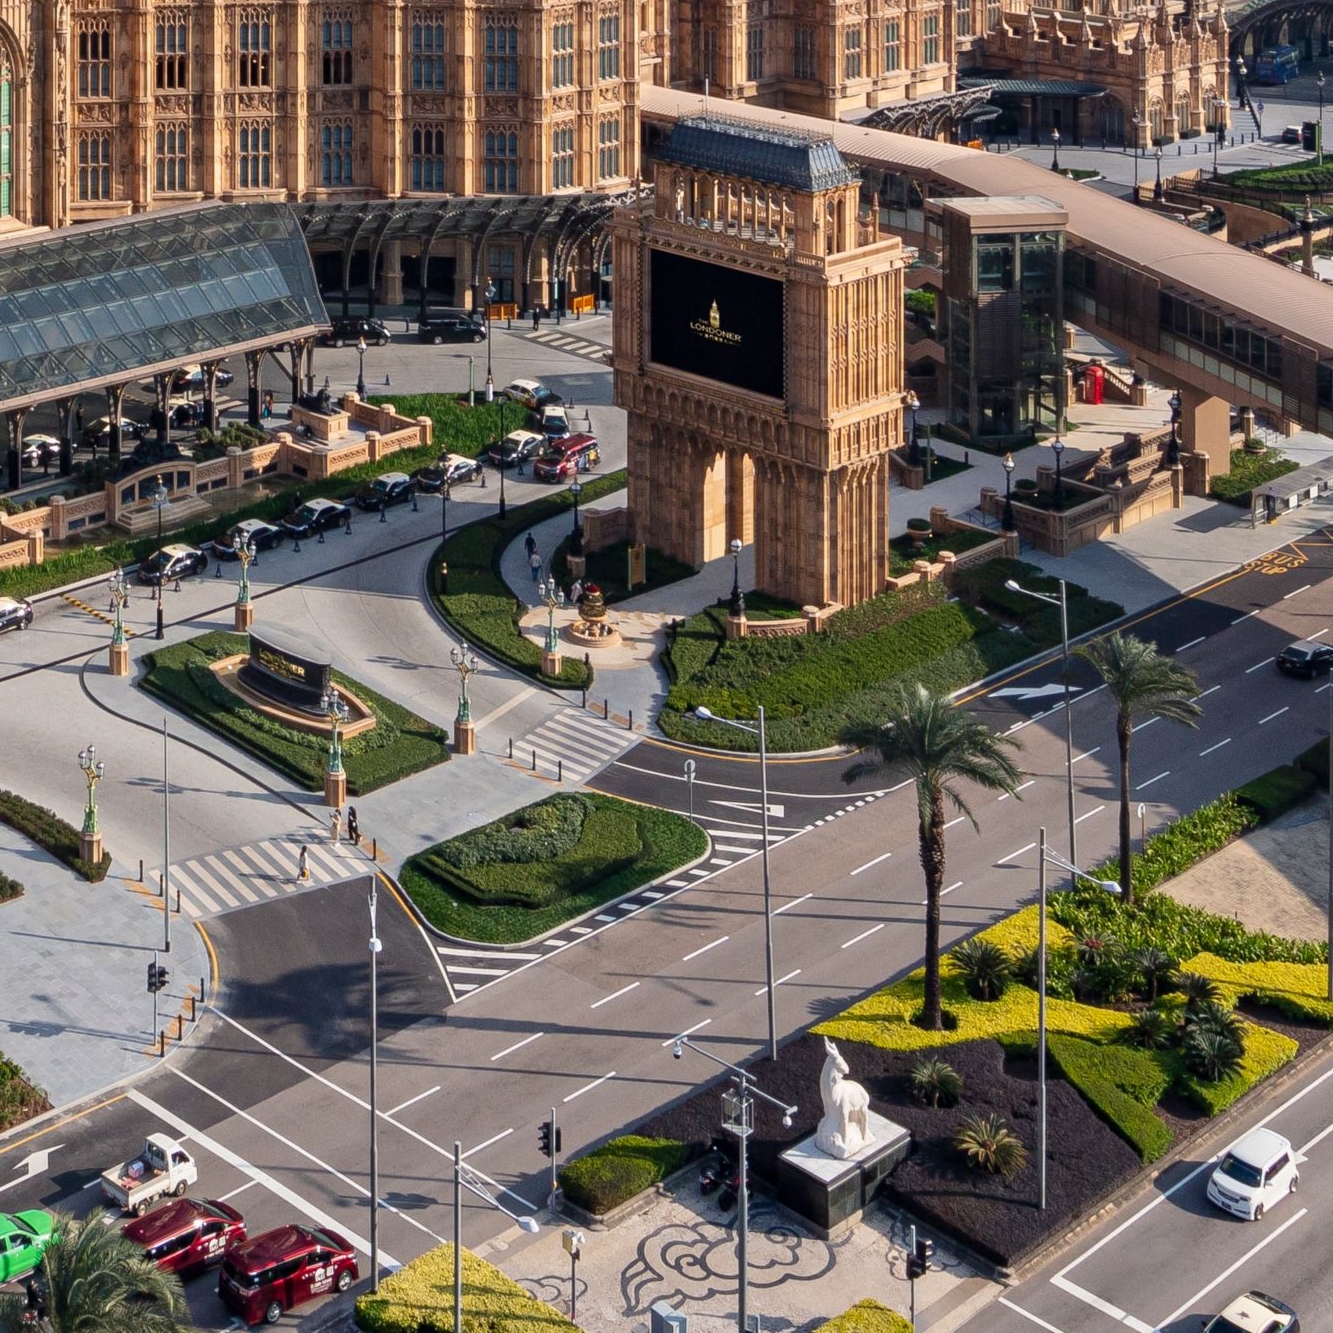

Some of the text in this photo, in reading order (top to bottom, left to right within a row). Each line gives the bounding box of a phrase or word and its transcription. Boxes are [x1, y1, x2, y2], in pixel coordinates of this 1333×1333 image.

[690, 321, 742, 342] LONDONER
[1244, 560, 1288, 575] STOP
[1260, 552, 1304, 568] BUS
